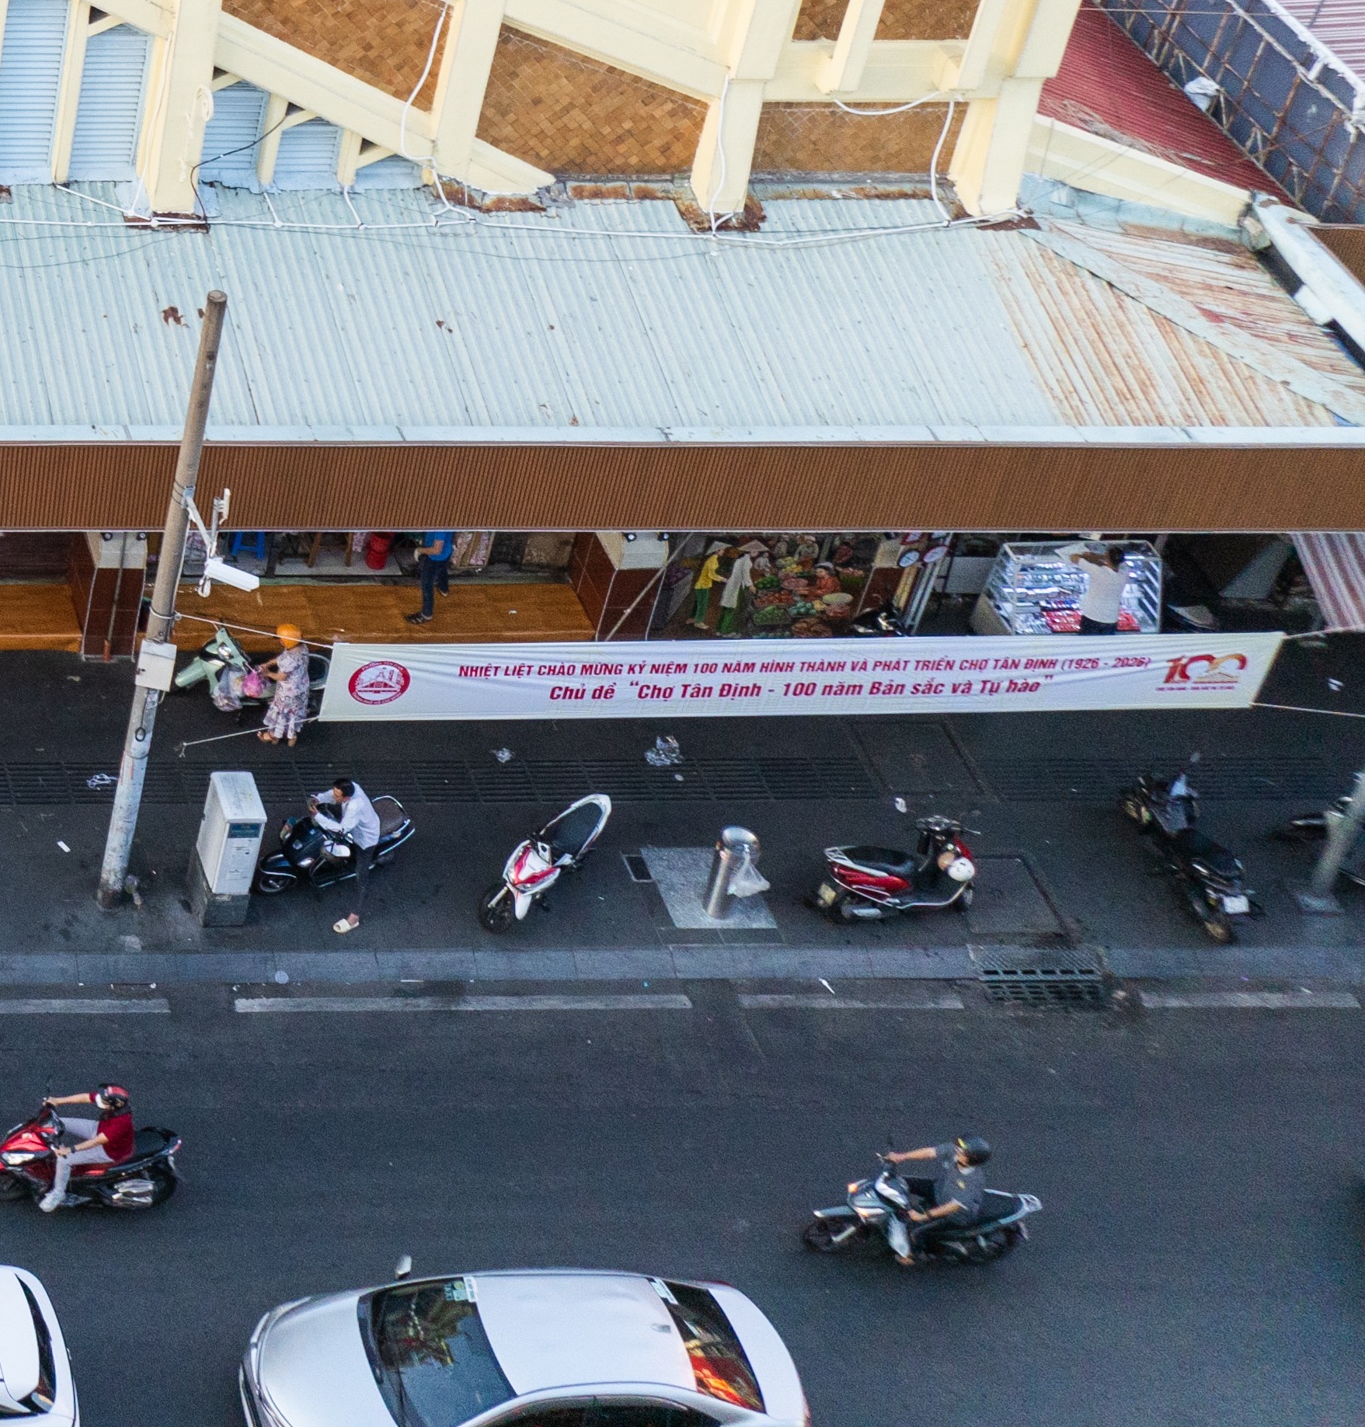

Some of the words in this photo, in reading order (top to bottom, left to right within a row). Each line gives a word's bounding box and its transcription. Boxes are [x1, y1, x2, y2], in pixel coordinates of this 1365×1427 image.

[459, 663, 500, 679] NHIỆT
[504, 663, 534, 678] LIỆT
[538, 662, 575, 676] CHÀO
[580, 661, 623, 676] MỪNG
[627, 660, 646, 674] KỶ
[650, 661, 688, 677] NIỆM
[693, 663, 718, 674] 100
[721, 659, 756, 673] NĂM
[759, 659, 795, 673] HÌNH
[800, 658, 846, 672] THÀNH
[850, 658, 868, 672] VÀ
[872, 657, 910, 671] PHÁT
[914, 654, 956, 671] TRIỂN
[959, 657, 988, 672] CHỢ
[992, 657, 1020, 670] TÂN
[1024, 657, 1058, 672] ĐỊNH
[1061, 657, 1100, 671] (1926
[550, 683, 586, 700] Chủ
[591, 682, 617, 700] đề
[681, 683, 713, 698] Tân
[719, 683, 762, 700] Định
[783, 682, 817, 696] 100
[821, 681, 863, 696] năm
[869, 679, 906, 695] Bản
[910, 676, 944, 695] sắc
[951, 679, 973, 694] và
[980, 679, 1001, 696] Tự
